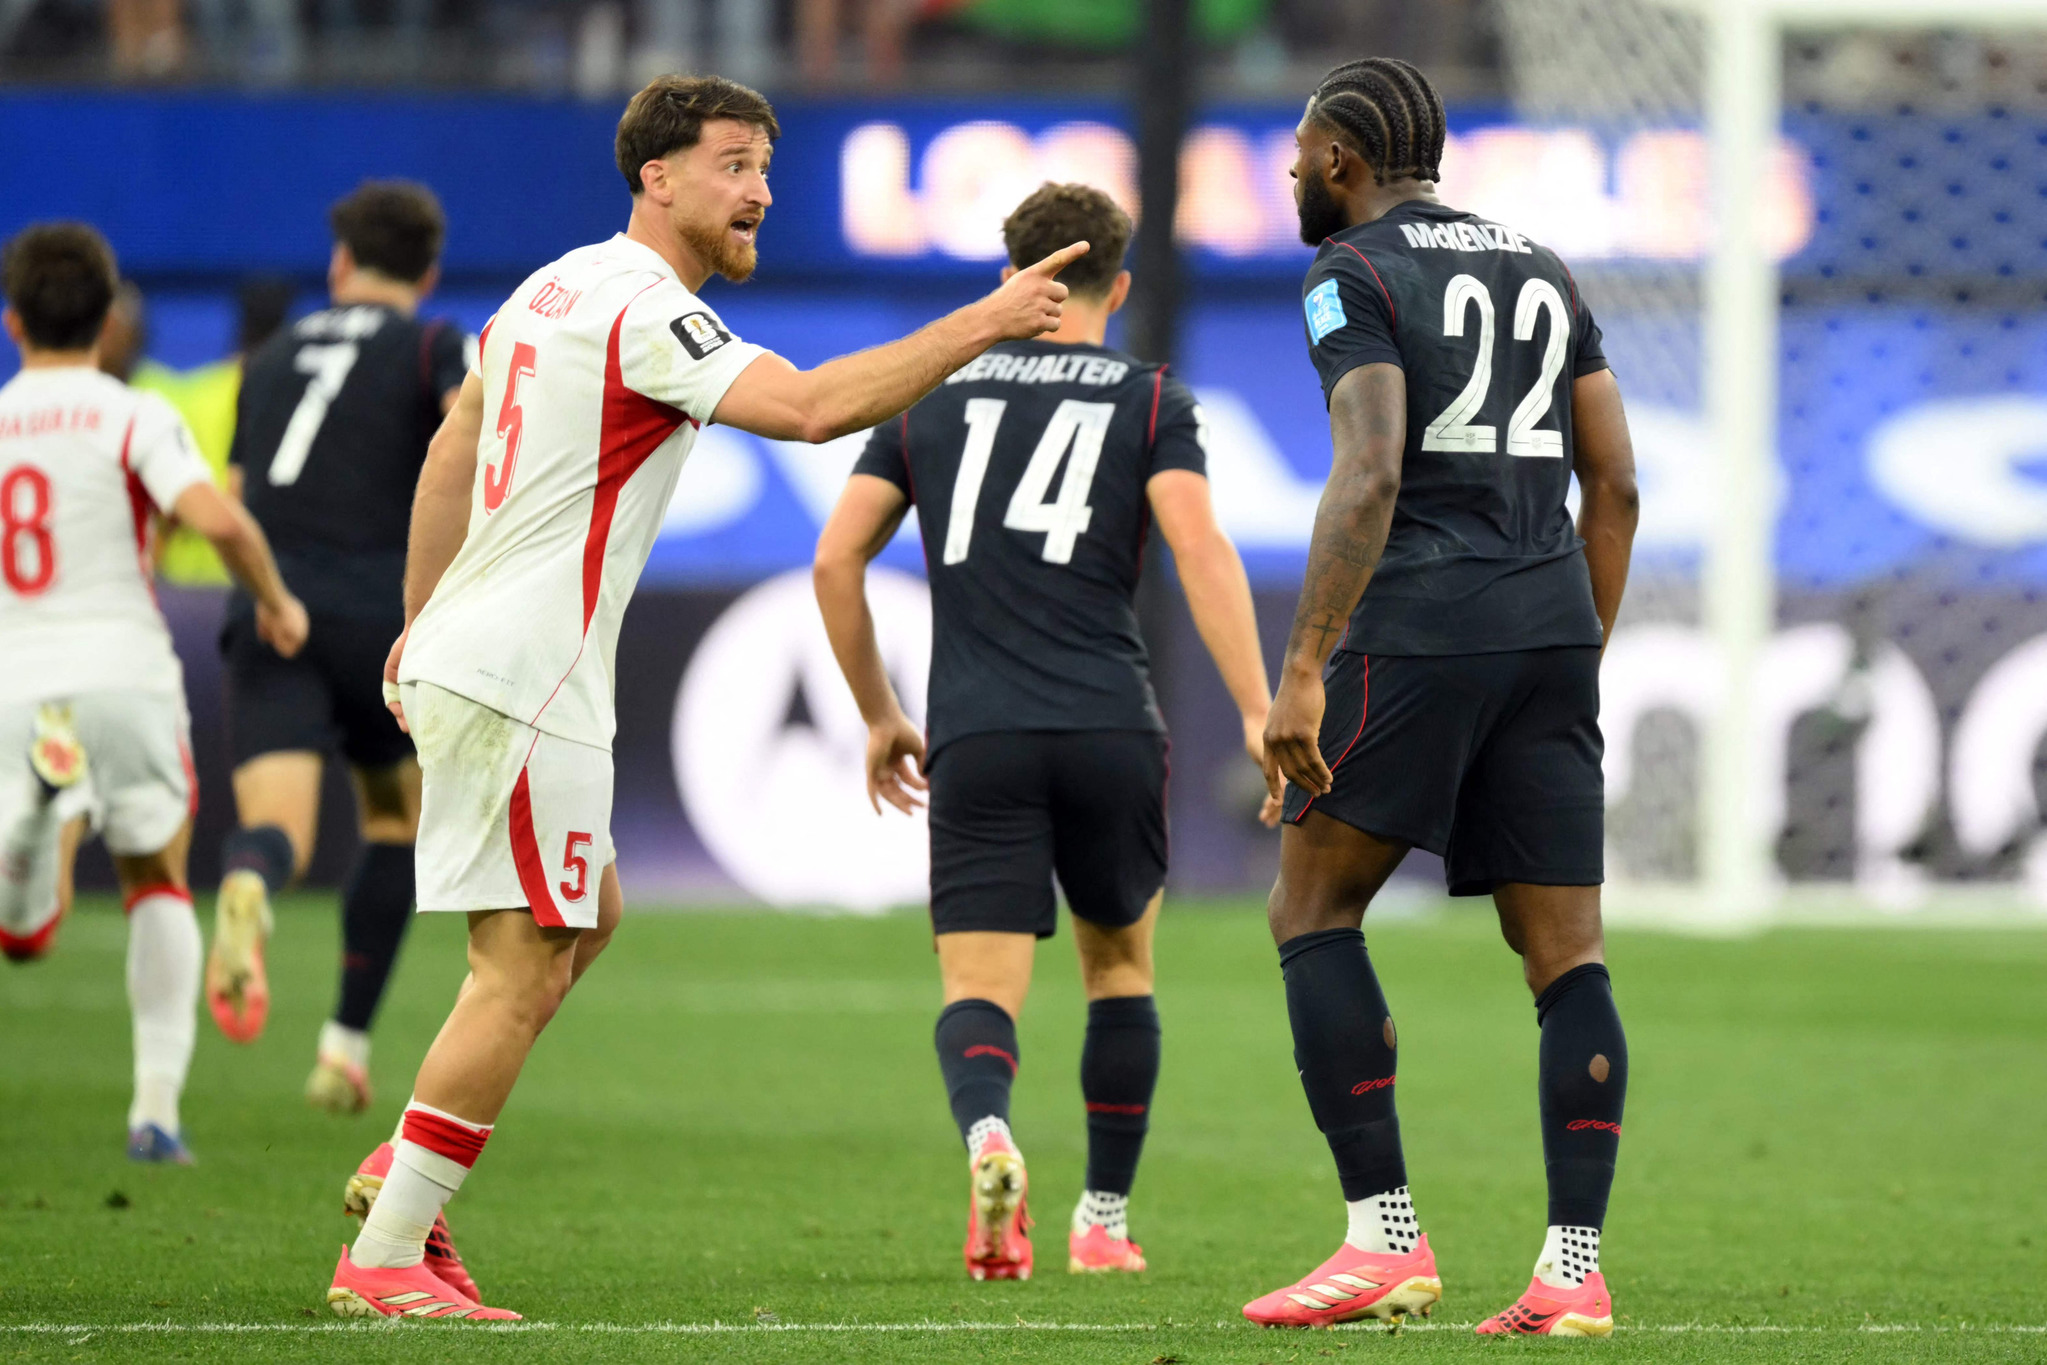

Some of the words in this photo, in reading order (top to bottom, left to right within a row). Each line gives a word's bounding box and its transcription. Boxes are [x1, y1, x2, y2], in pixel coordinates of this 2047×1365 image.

[268, 341, 360, 487] 7
[484, 341, 538, 516] 5
[1421, 274, 1570, 458] 22
[1, 464, 56, 598] 8
[943, 398, 1116, 565] 14
[560, 831, 593, 903] 5
